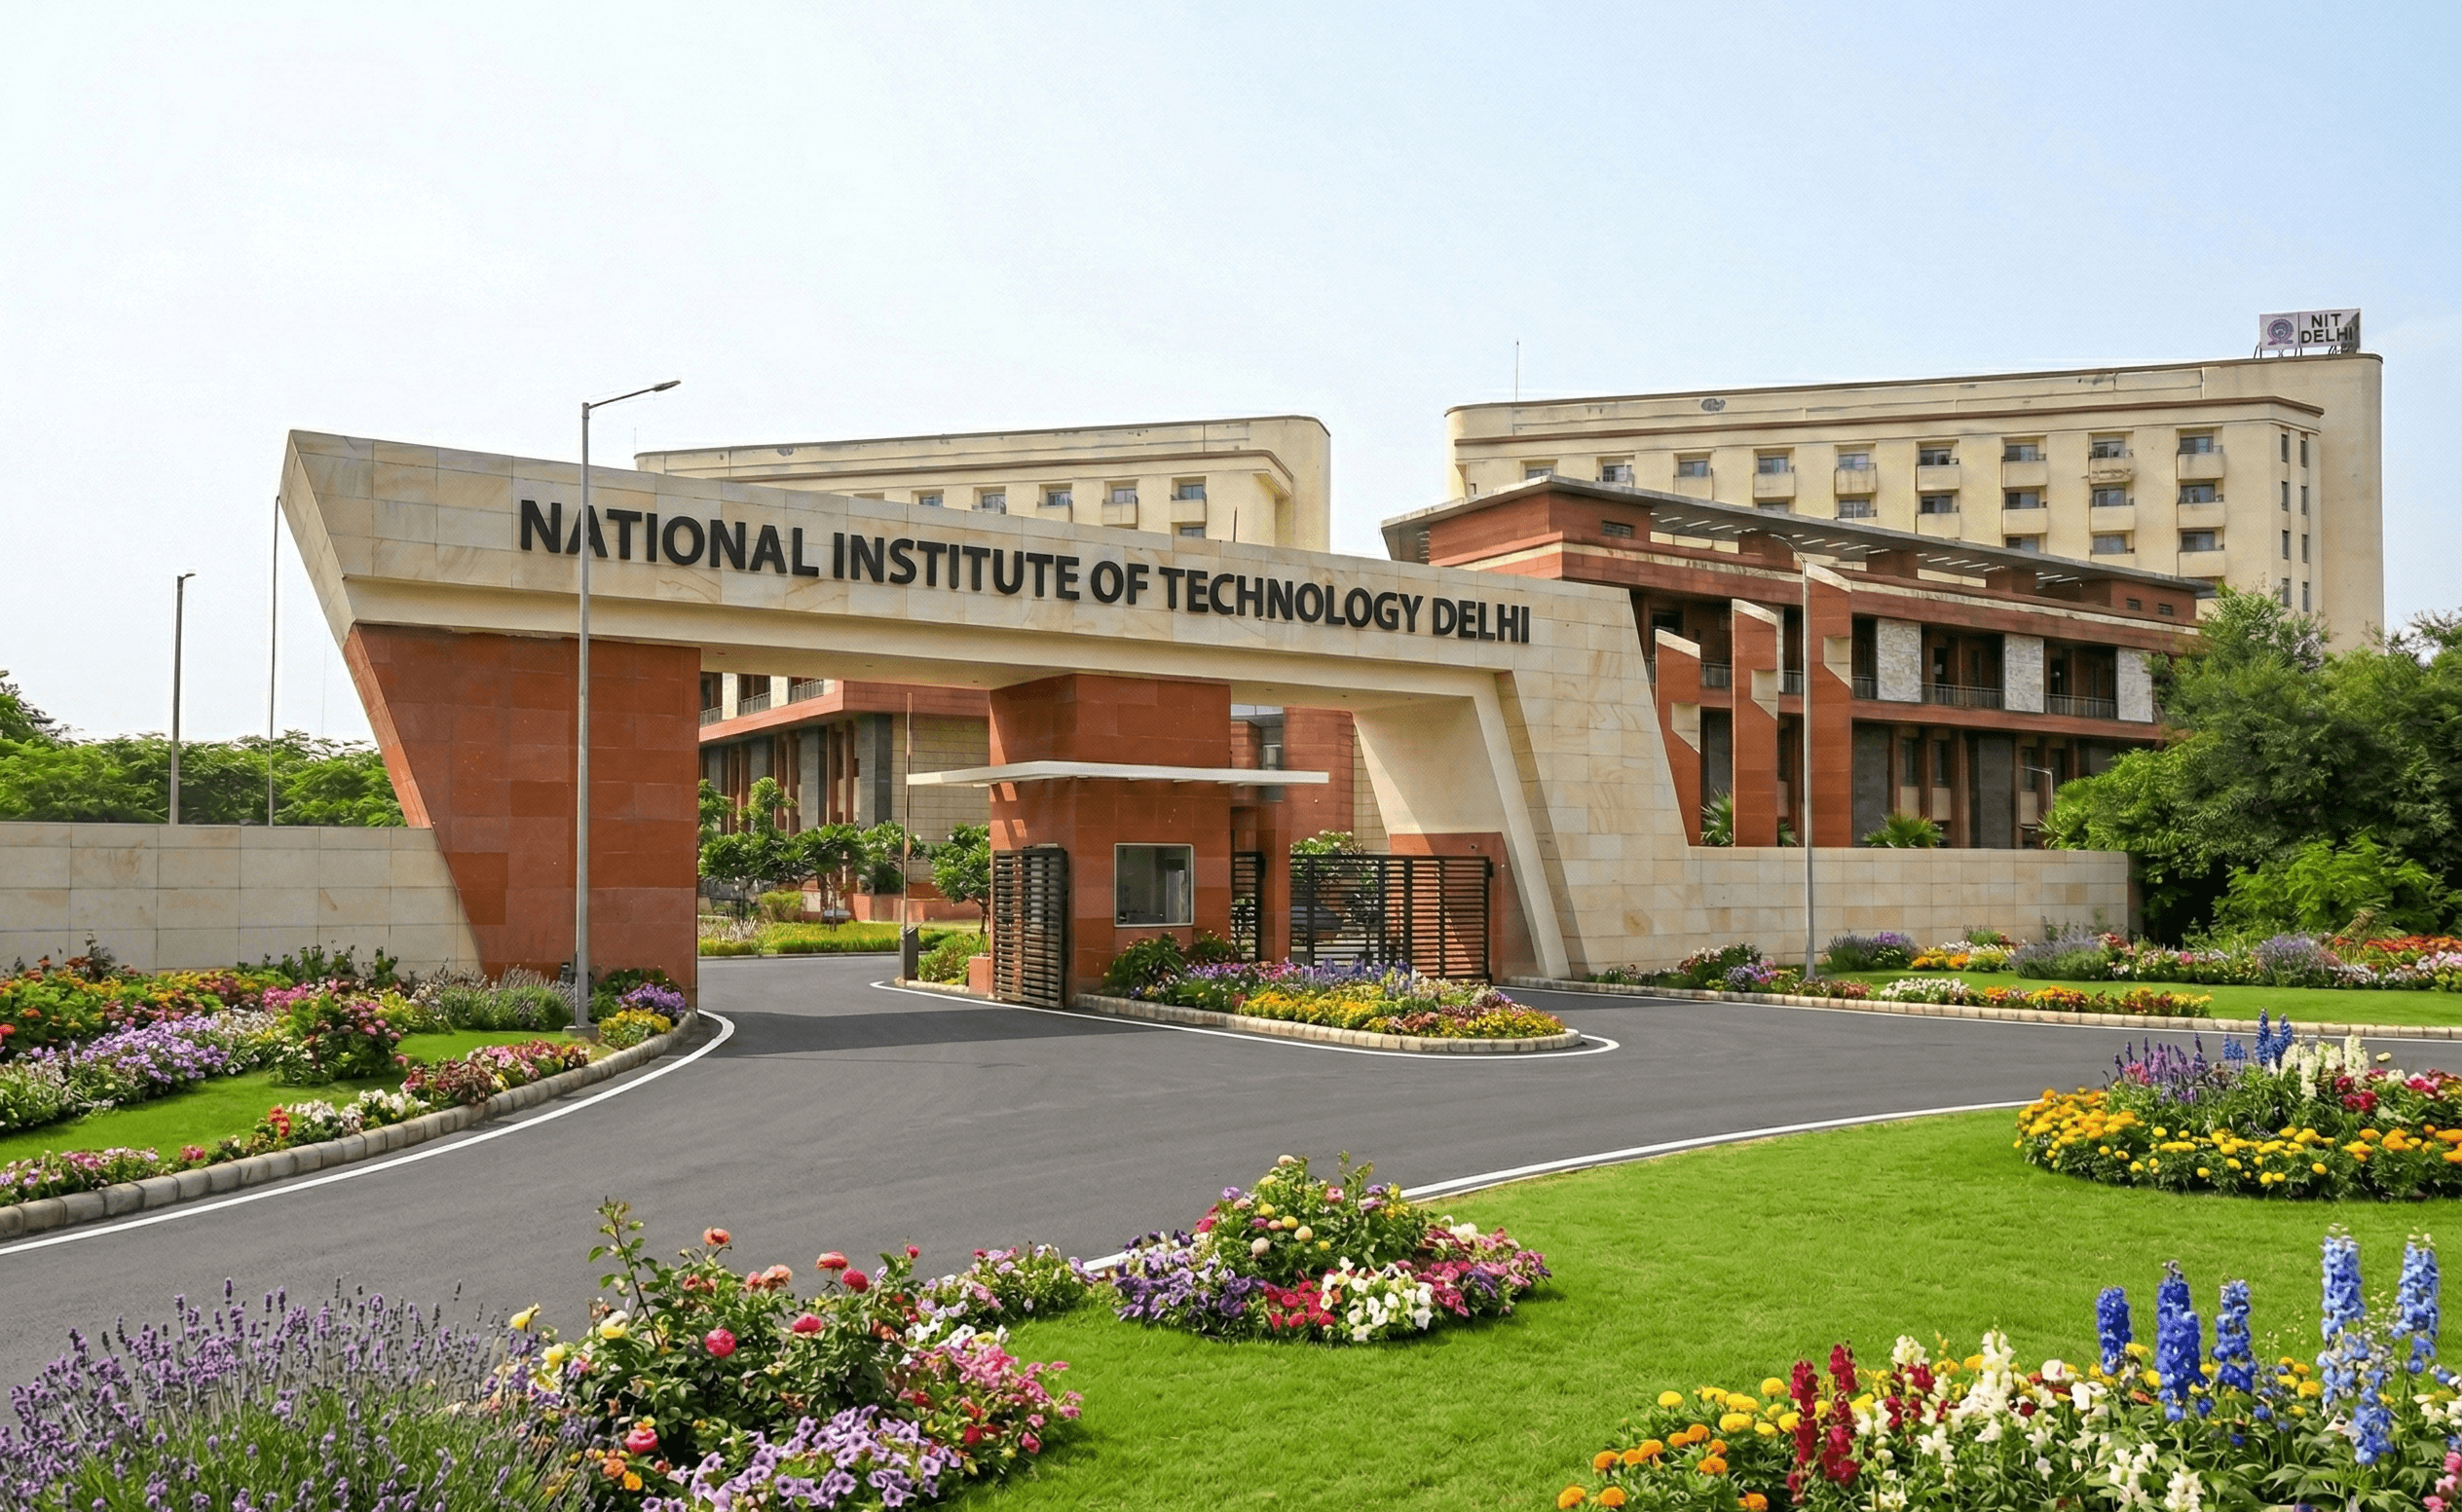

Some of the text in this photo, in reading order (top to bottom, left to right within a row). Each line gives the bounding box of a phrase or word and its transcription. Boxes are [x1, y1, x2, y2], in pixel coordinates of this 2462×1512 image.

[2311, 313, 2341, 328] NIT
[2300, 326, 2353, 344] DELHI
[520, 498, 1530, 645] NATIONAL INSTITUTE OF TECHNOLOGY DELHI
